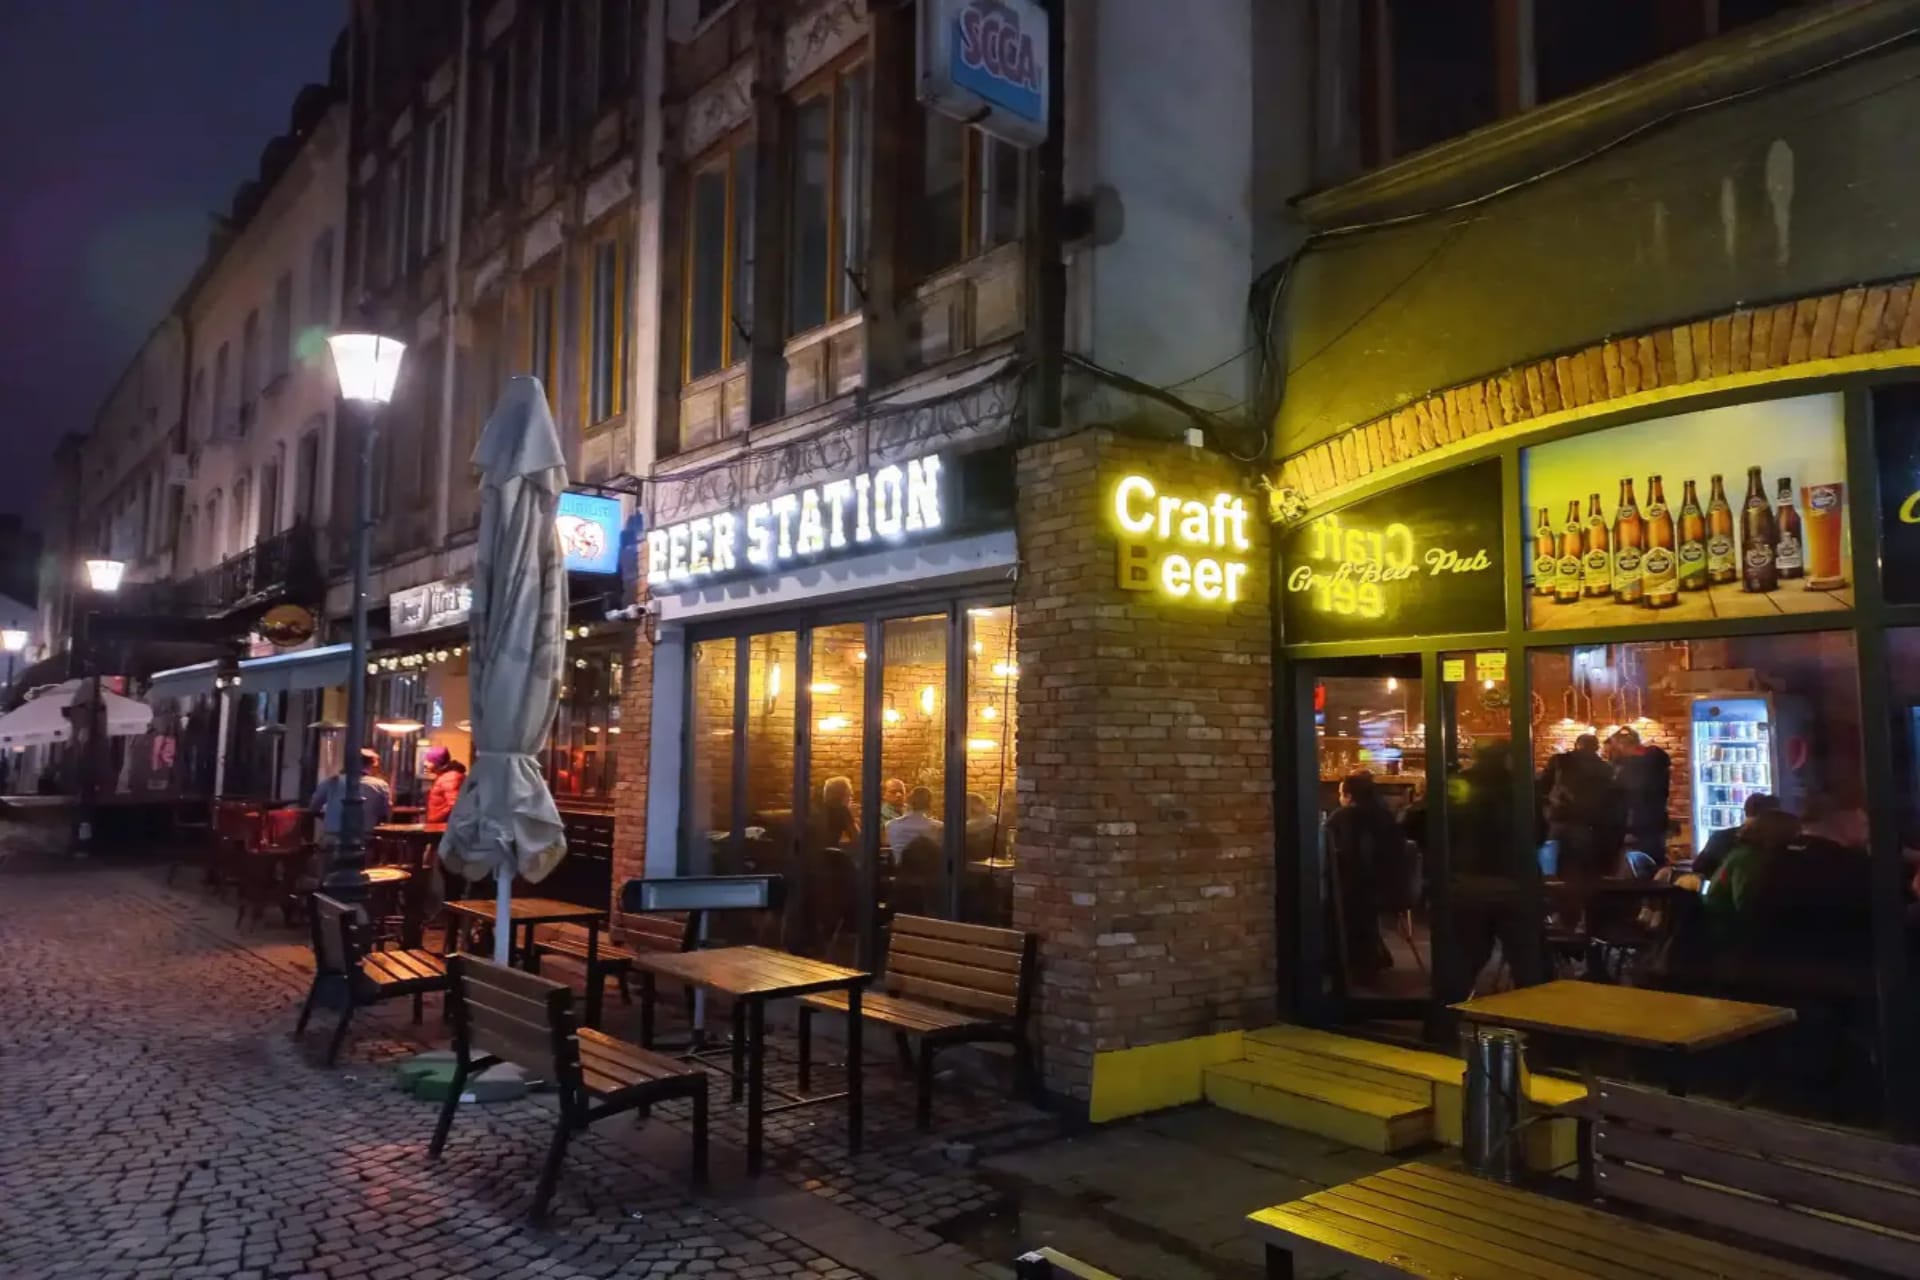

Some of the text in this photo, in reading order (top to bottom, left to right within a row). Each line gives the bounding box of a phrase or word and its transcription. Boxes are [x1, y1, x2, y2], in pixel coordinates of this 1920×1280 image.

[647, 454, 942, 583] BEER STATION
[1115, 475, 1249, 550] Craft
[1117, 541, 1247, 602] Beer
[1354, 559, 1420, 584] Beer
[1425, 548, 1492, 576] Pub
